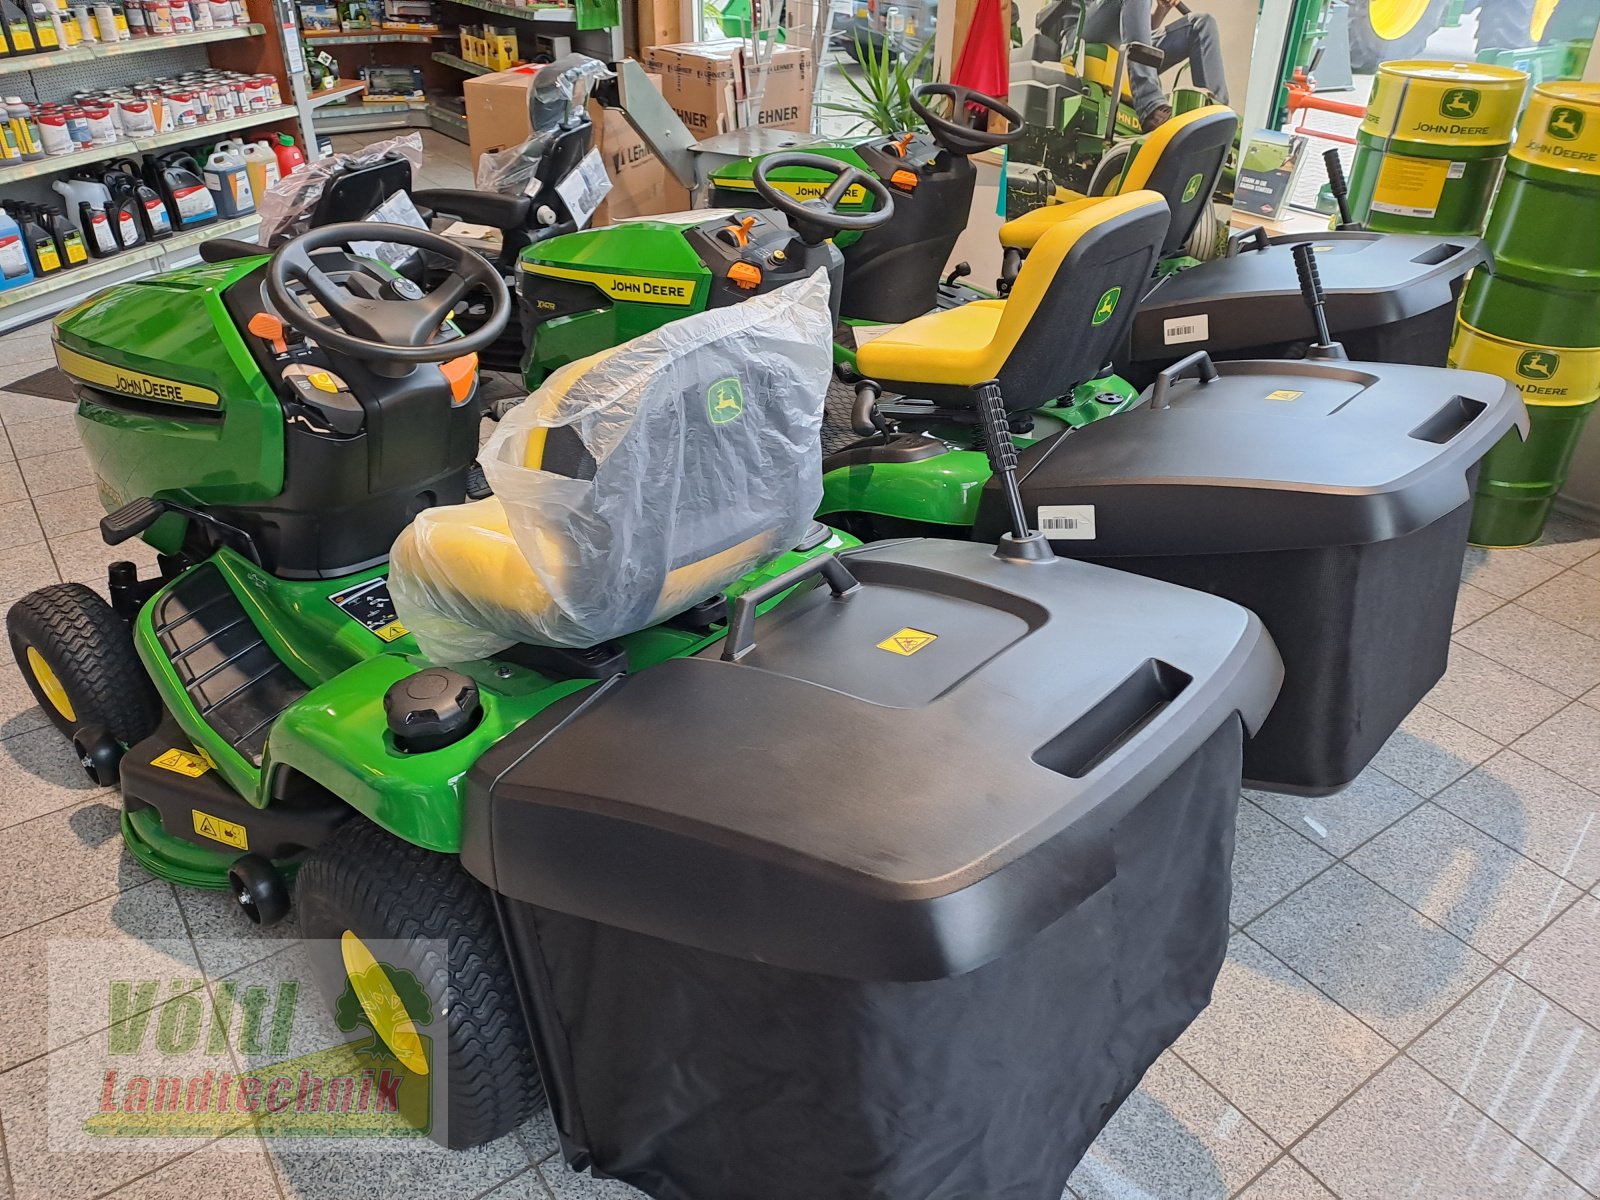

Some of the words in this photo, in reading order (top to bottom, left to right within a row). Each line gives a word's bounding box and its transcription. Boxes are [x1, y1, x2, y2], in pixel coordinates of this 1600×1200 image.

[673, 107, 708, 128] HNER
[758, 106, 798, 124] EHNER
[1413, 122, 1449, 134] JOHN
[1450, 124, 1490, 135] DEERE
[1525, 140, 1552, 154] JOHN
[1553, 146, 1598, 161] DEERE
[796, 187, 820, 196] JOHN
[611, 279, 640, 294] JOHN
[643, 282, 685, 297] DEERE
[115, 374, 142, 393] JOHN
[143, 379, 182, 399] DEERE
[1526, 384, 1568, 396] DEERE
